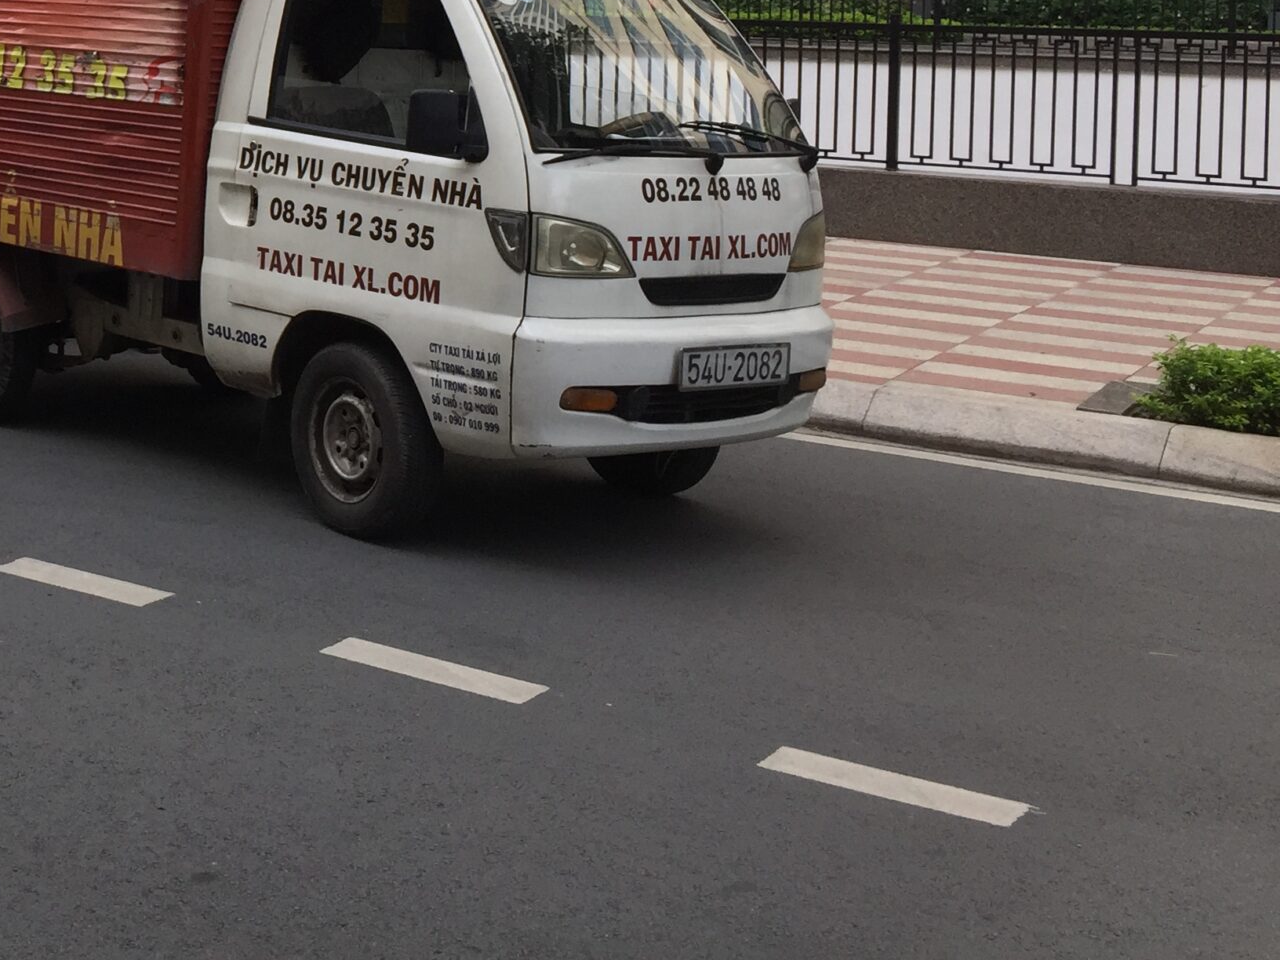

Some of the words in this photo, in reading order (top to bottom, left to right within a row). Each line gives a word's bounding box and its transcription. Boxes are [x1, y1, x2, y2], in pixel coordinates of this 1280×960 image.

[35, 48, 77, 95] 35
[238, 144, 290, 178] DỊCH
[296, 155, 324, 189] VỤ
[331, 158, 425, 200] CHUYỂN
[431, 176, 483, 211] NHÀ
[641, 176, 702, 203] 08.22
[707, 176, 731, 202] 48
[736, 176, 758, 202] 48
[761, 177, 782, 202] 48
[269, 196, 328, 231] 08.35
[335, 209, 363, 238] 12
[368, 215, 398, 244] 35
[404, 222, 435, 252] 35
[627, 235, 681, 262] TAXI
[687, 235, 721, 261] TAI
[727, 231, 792, 260] XL.COM
[256, 246, 304, 278] TAXI
[309, 256, 345, 287] TAI
[351, 264, 441, 305] XL.COM
[206, 322, 268, 349] 54U.2082
[429, 342, 443, 354] CTY
[444, 344, 460, 358] TAXI
[486, 370, 499, 382] KG
[489, 387, 502, 400] KG
